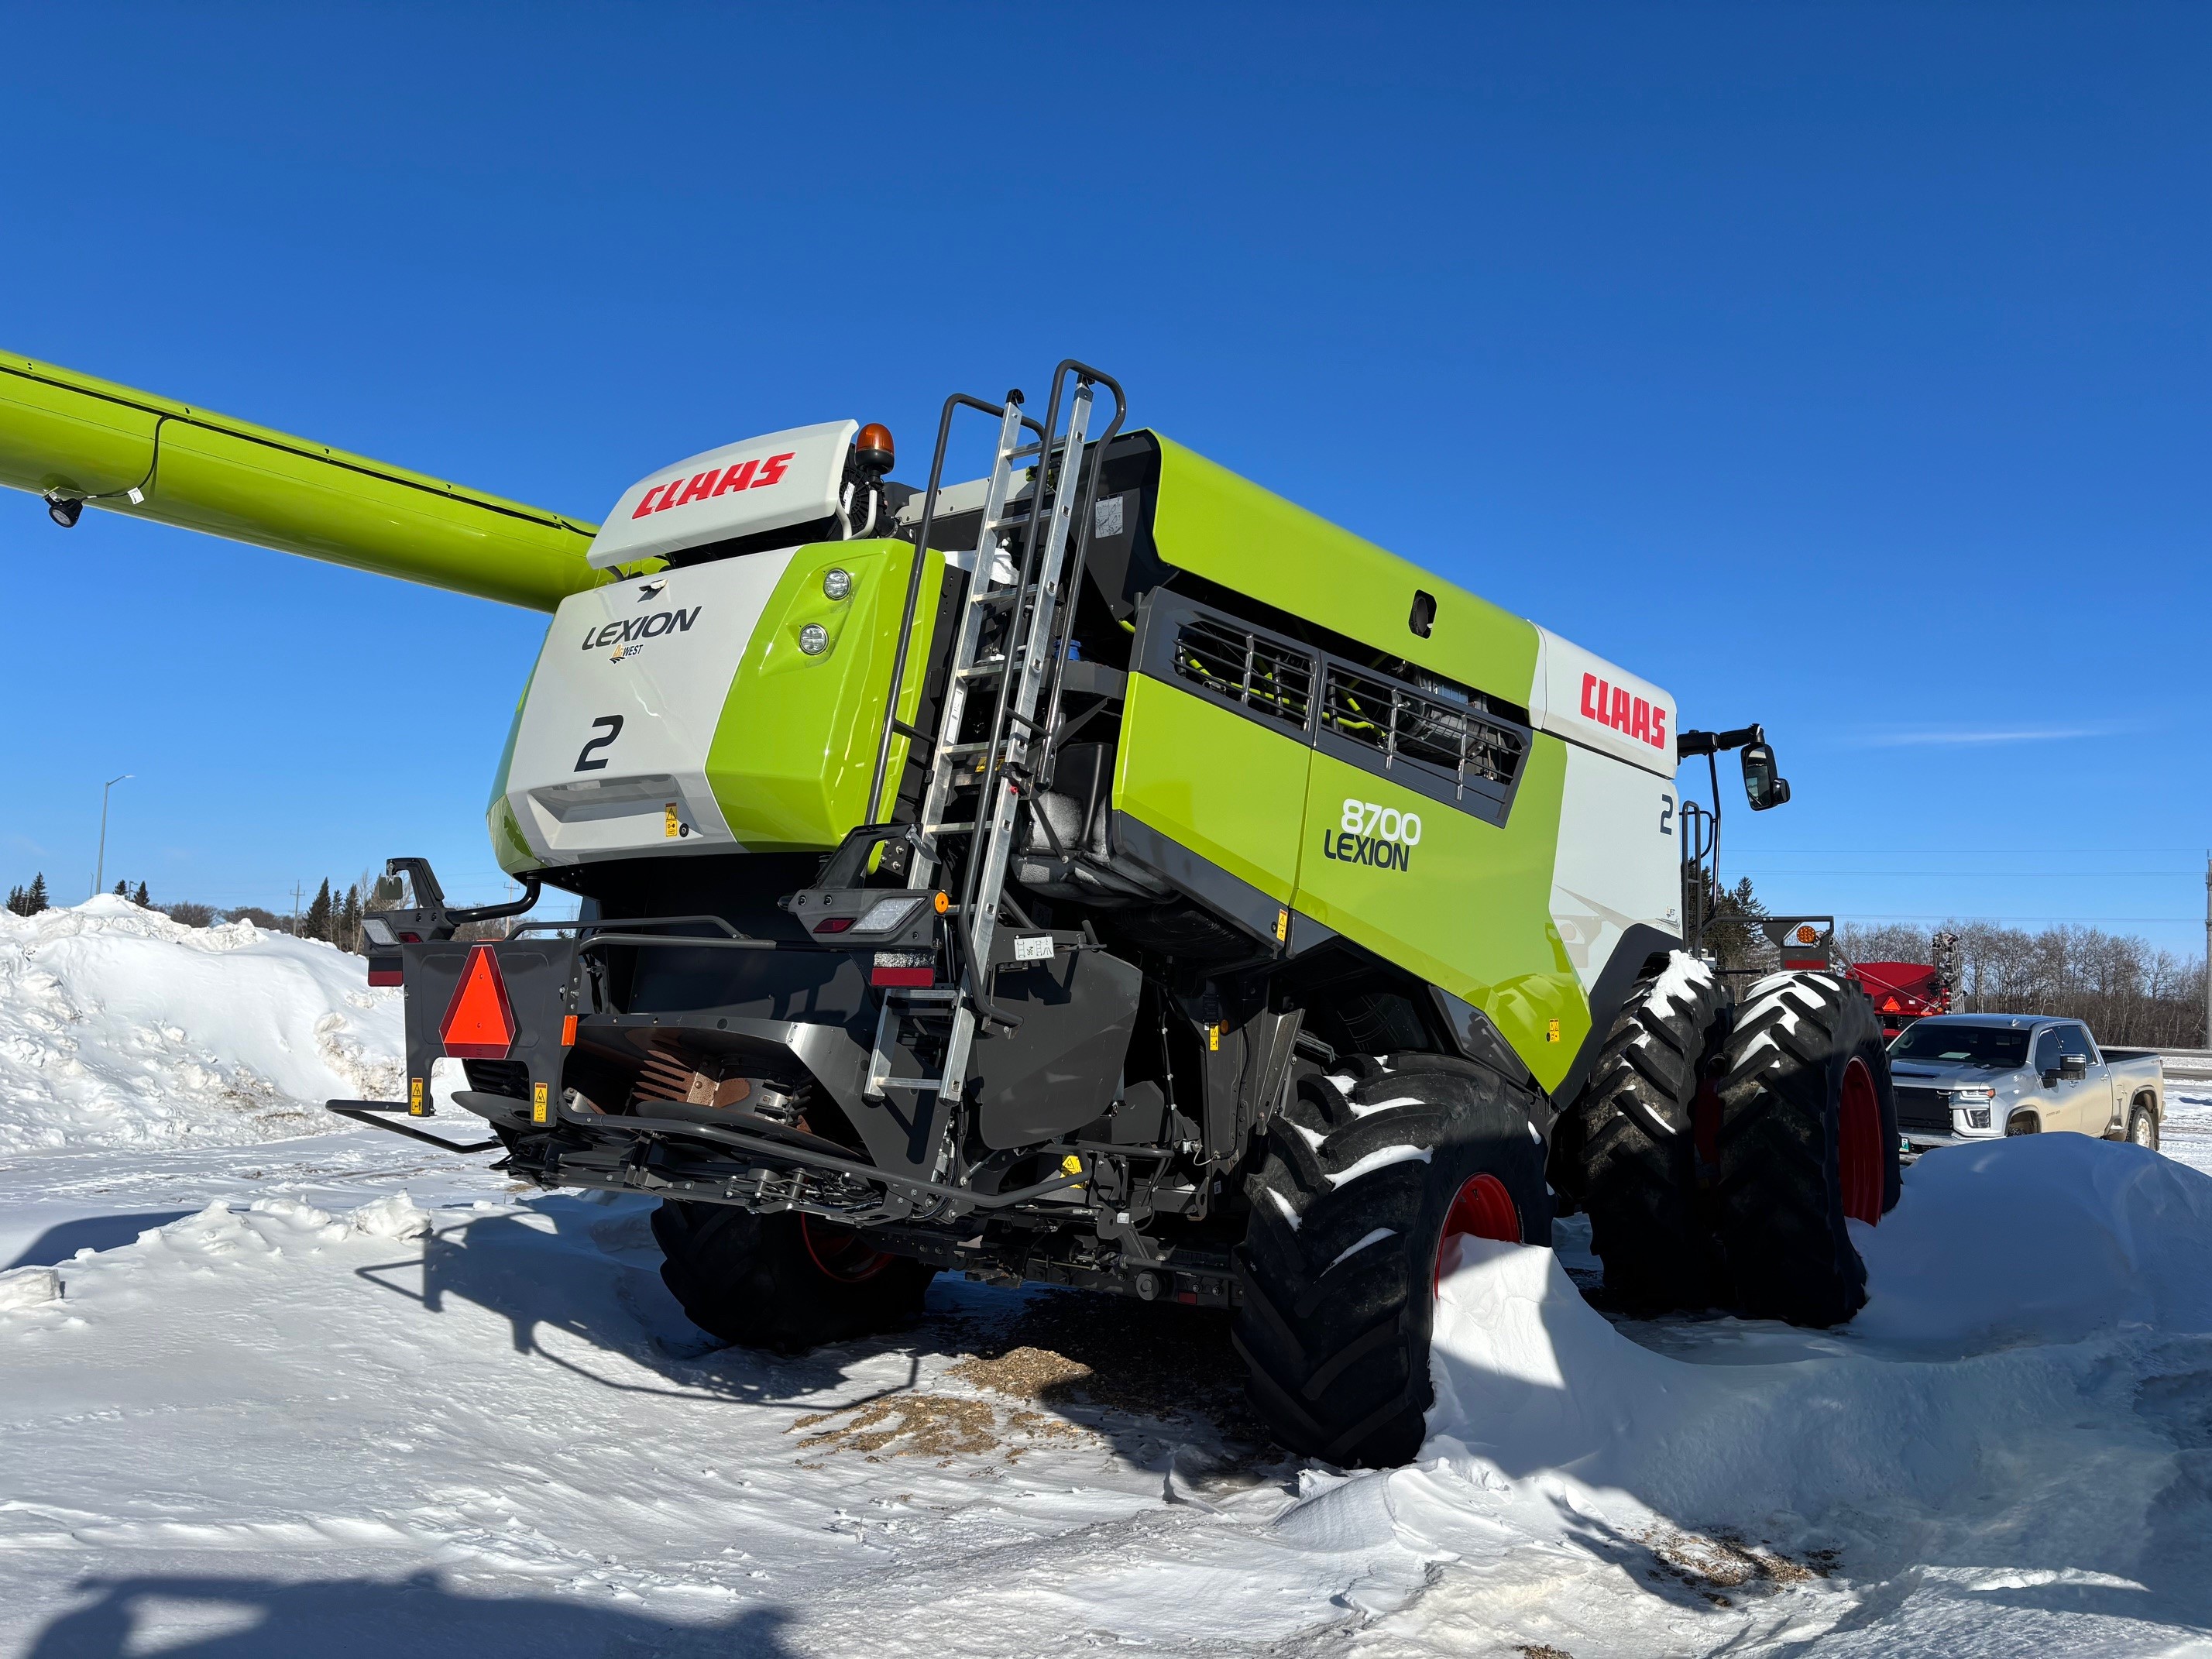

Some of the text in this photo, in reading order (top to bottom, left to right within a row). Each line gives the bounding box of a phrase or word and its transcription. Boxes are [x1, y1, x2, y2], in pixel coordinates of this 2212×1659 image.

[632, 452, 795, 520] CLAAS
[581, 606, 702, 651] LEXION
[1580, 672, 1666, 750] CLAAS
[574, 714, 624, 773] 2
[1341, 798, 1422, 846] 8700
[1660, 793, 1674, 836] 2
[1324, 829, 1410, 872] LEXION
